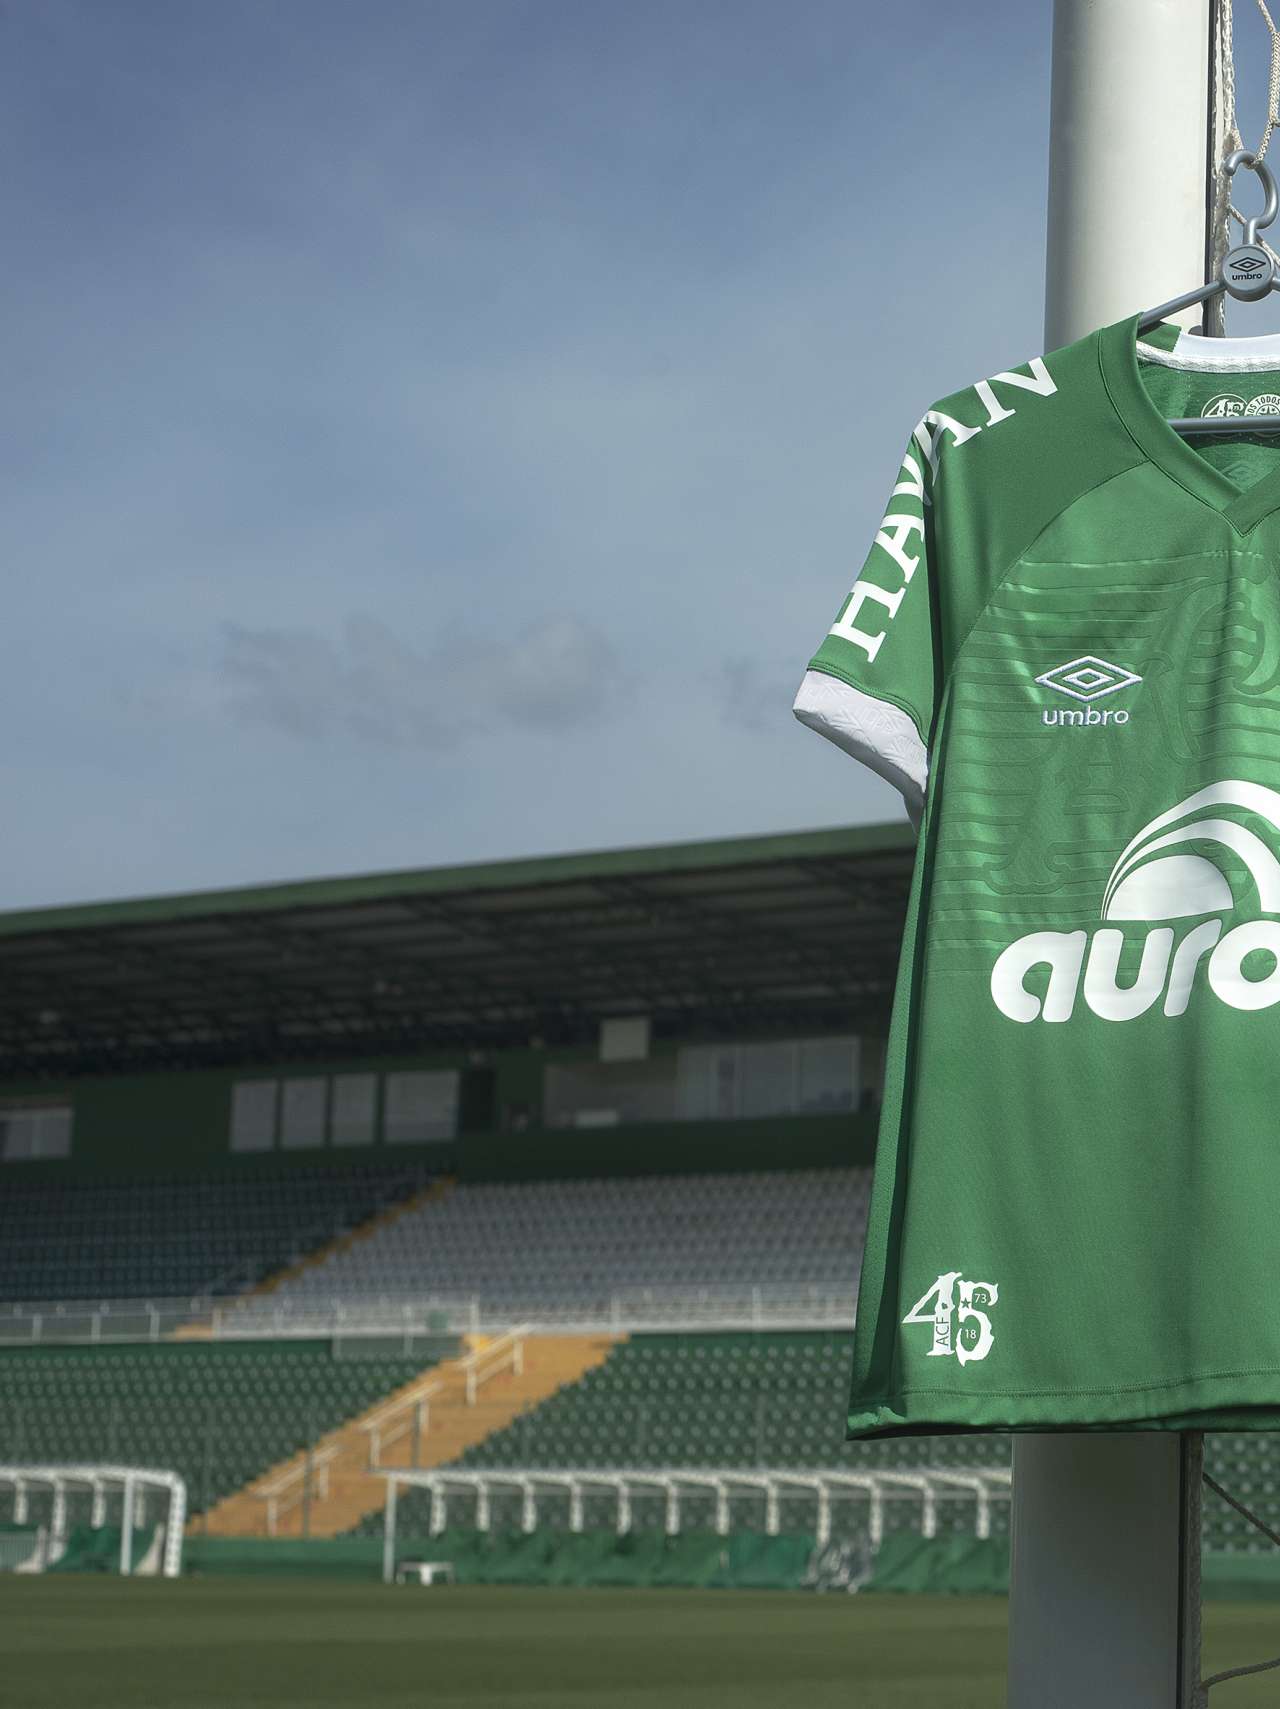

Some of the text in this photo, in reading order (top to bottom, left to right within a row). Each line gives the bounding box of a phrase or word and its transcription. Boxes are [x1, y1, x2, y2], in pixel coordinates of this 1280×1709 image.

[830, 357, 1058, 663] HAVAN
[1042, 705, 1129, 726] umbro
[974, 1293, 987, 1304] 73
[936, 1317, 949, 1346] ACF
[965, 1329, 977, 1339] 18
